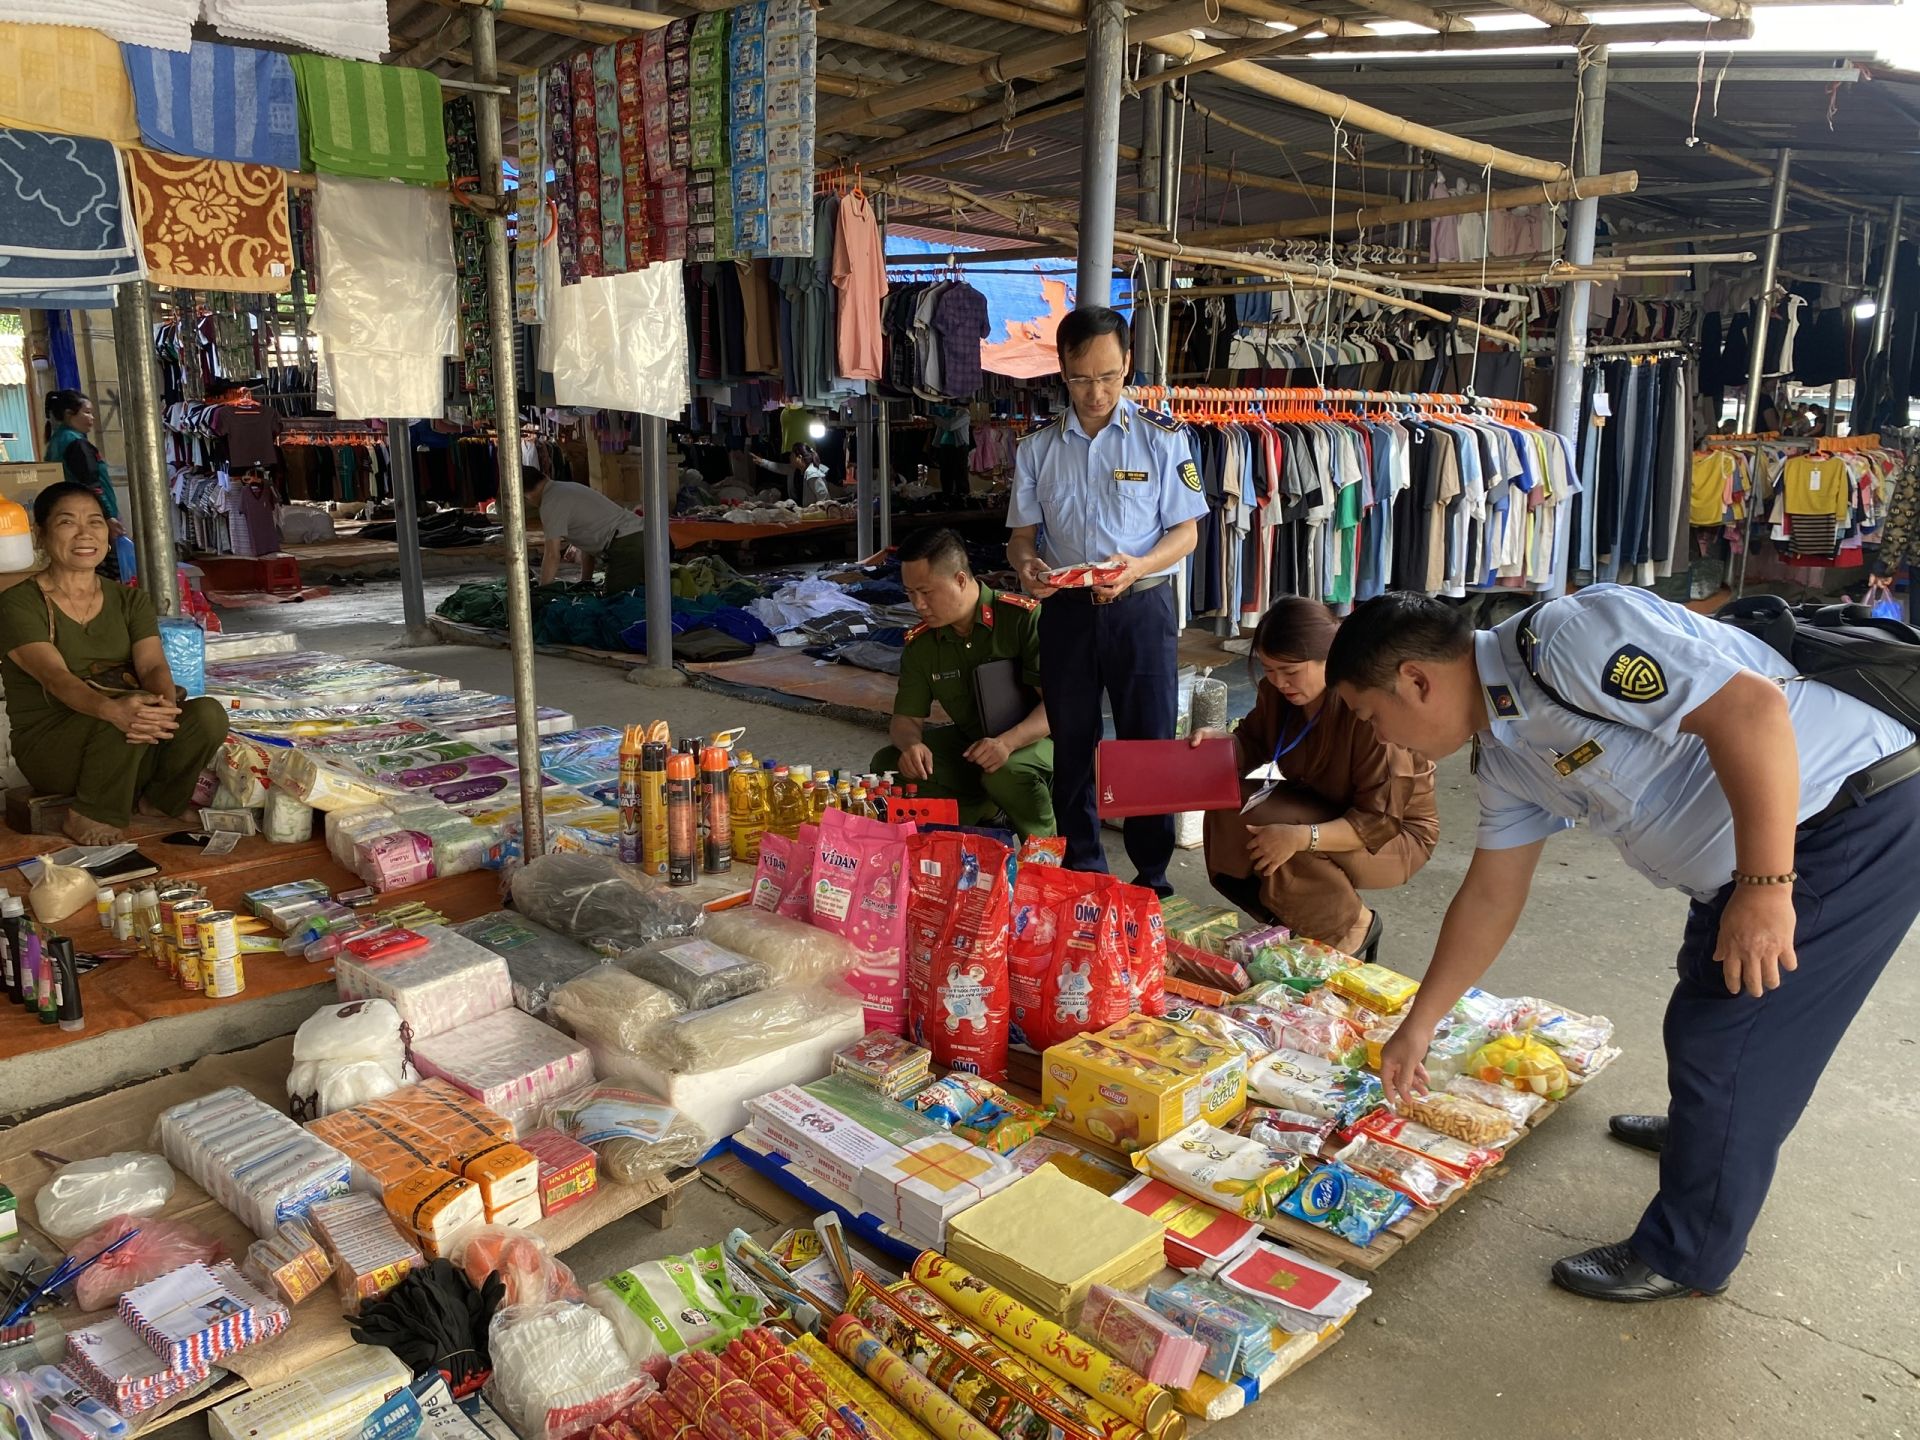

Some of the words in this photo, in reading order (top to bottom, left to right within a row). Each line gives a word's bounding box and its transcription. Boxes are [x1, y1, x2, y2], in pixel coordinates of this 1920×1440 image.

[1609, 653, 1631, 685] DMS
[1075, 903, 1102, 924] OMO
[1099, 1086, 1128, 1105] Custard
[569, 1160, 591, 1176] MINH
[548, 1173, 567, 1185] ANH
[252, 1379, 302, 1404] MERUFA
[383, 1403, 411, 1428] ANH
